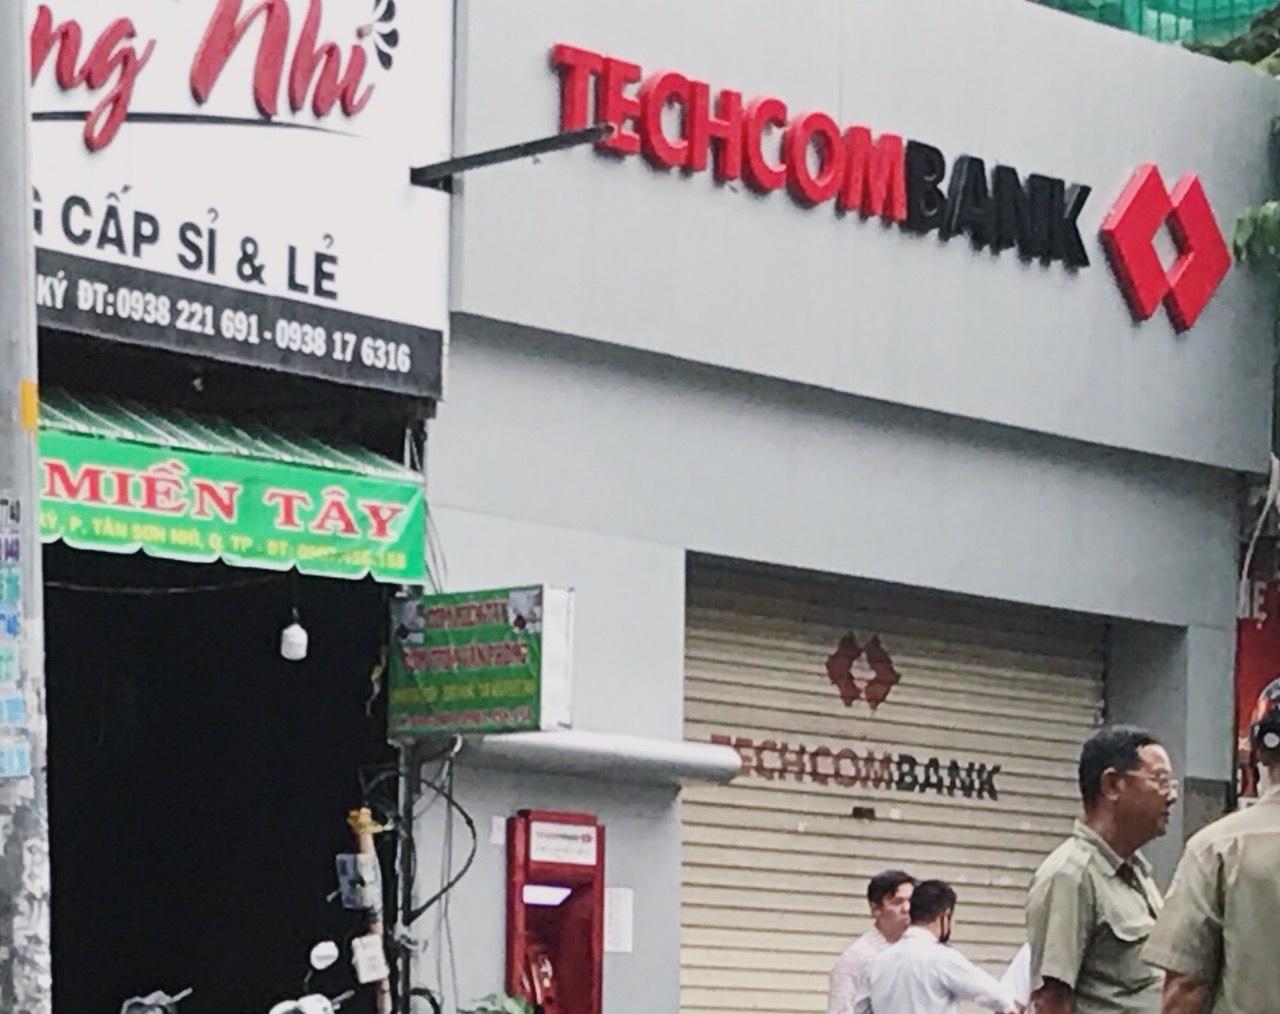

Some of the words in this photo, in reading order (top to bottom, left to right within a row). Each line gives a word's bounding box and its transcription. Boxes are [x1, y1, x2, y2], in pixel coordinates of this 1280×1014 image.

[190, 0, 375, 117] Nhi
[550, 42, 1092, 270] TECHCOMBANK
[61, 184, 159, 258] CẤP
[177, 208, 218, 275] SỈ
[236, 236, 266, 287] &
[287, 233, 339, 300] LẺ
[175, 299, 216, 336] 221
[332, 331, 357, 363] 17
[360, 336, 412, 373] 6316
[41, 461, 239, 521] MIỀN
[264, 488, 405, 538] TÂY
